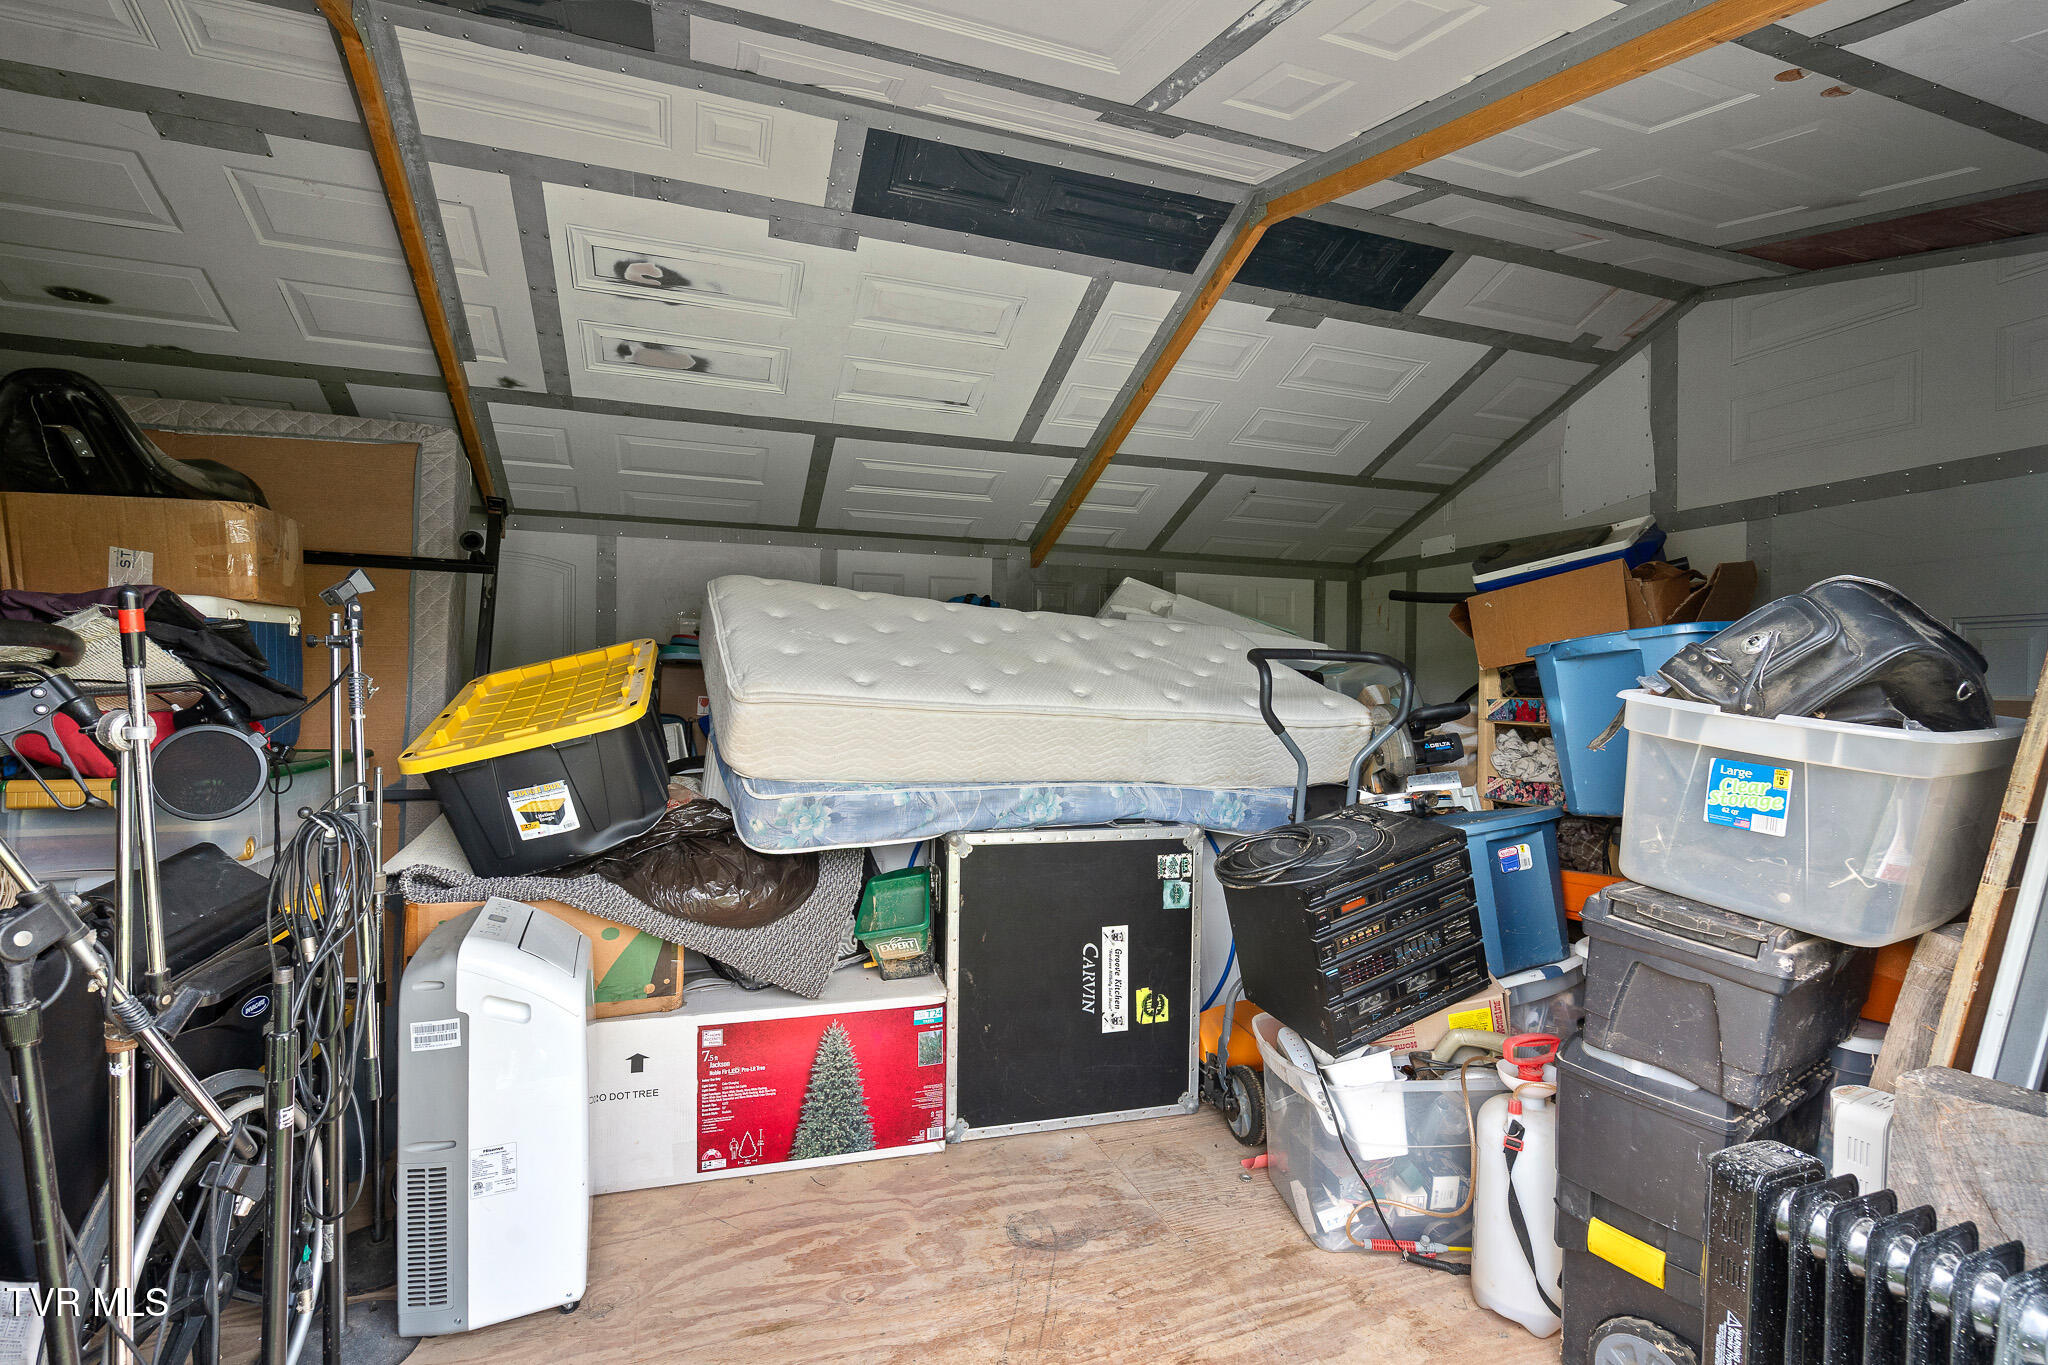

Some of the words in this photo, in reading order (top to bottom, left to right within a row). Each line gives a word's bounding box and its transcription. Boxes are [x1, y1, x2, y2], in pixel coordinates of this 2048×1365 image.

[1720, 765, 1753, 779] Large
[543, 782, 562, 792] BOX
[1719, 777, 1772, 796] Clear
[1707, 789, 1785, 812] Storage
[880, 940, 915, 952] EXPERT
[1114, 948, 1123, 976] Groove
[1082, 943, 1099, 1014] CARVIN
[1114, 978, 1123, 1010] Kitchen
[709, 1061, 731, 1069] Jackson
[609, 1092, 631, 1101] DOT
[632, 1088, 659, 1099] TREE
